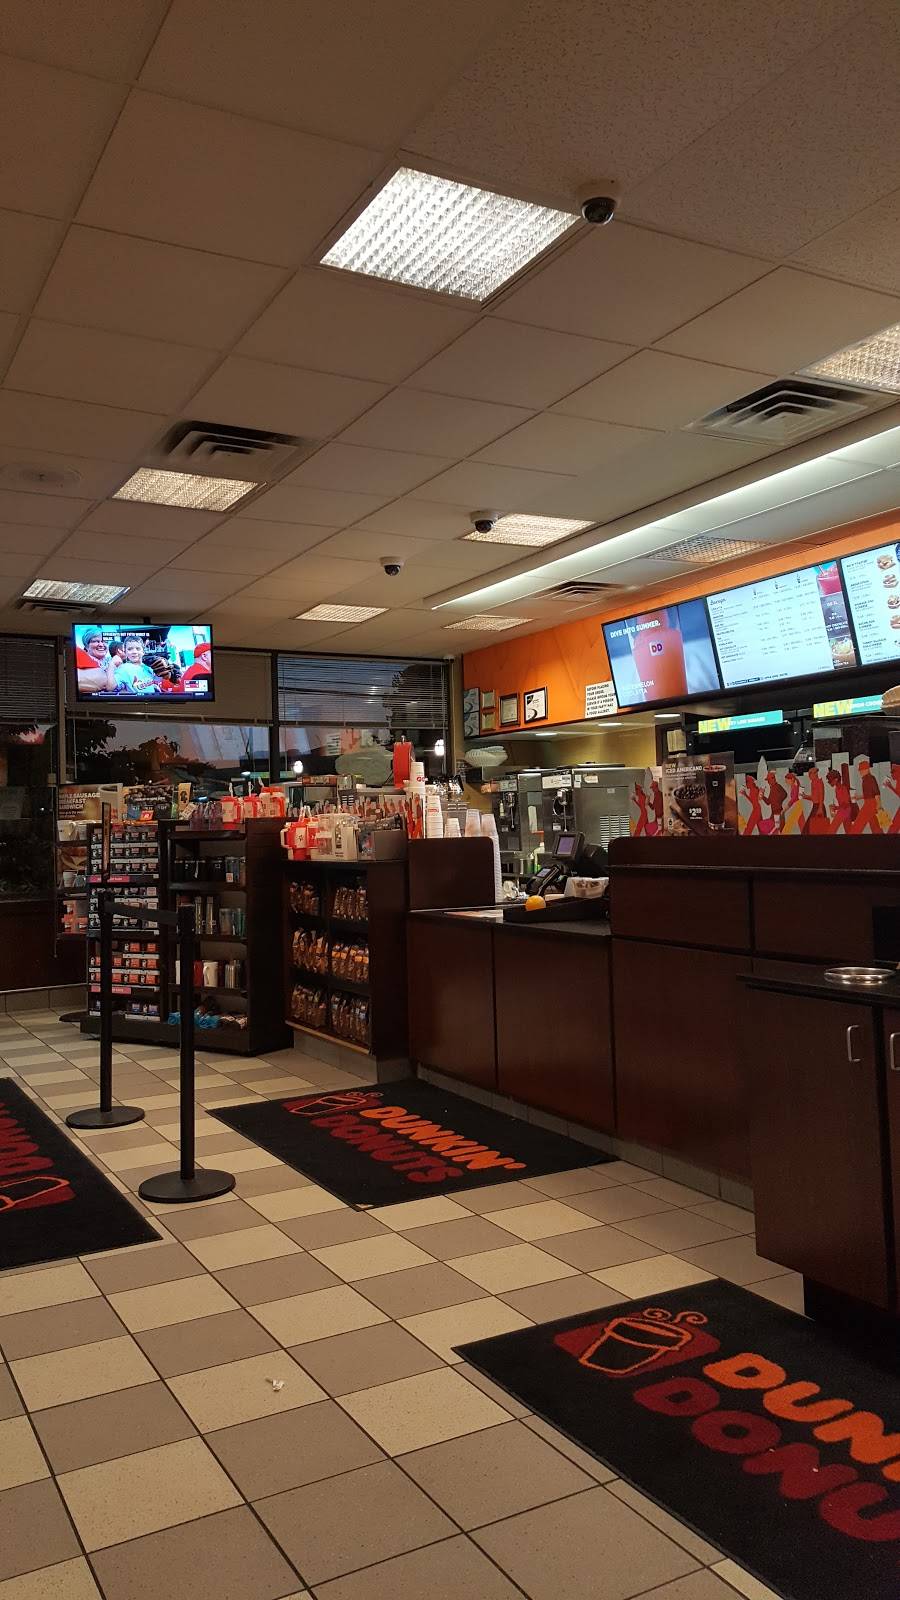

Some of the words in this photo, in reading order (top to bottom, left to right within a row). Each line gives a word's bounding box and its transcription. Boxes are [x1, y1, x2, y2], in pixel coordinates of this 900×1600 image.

[609, 629, 622, 638] DIVE
[622, 626, 635, 635] INTO
[651, 643, 663, 653] DD
[310, 1114, 464, 1183] DONUTS
[703, 1352, 900, 1481] DUN
[633, 1377, 900, 1541] DONU
